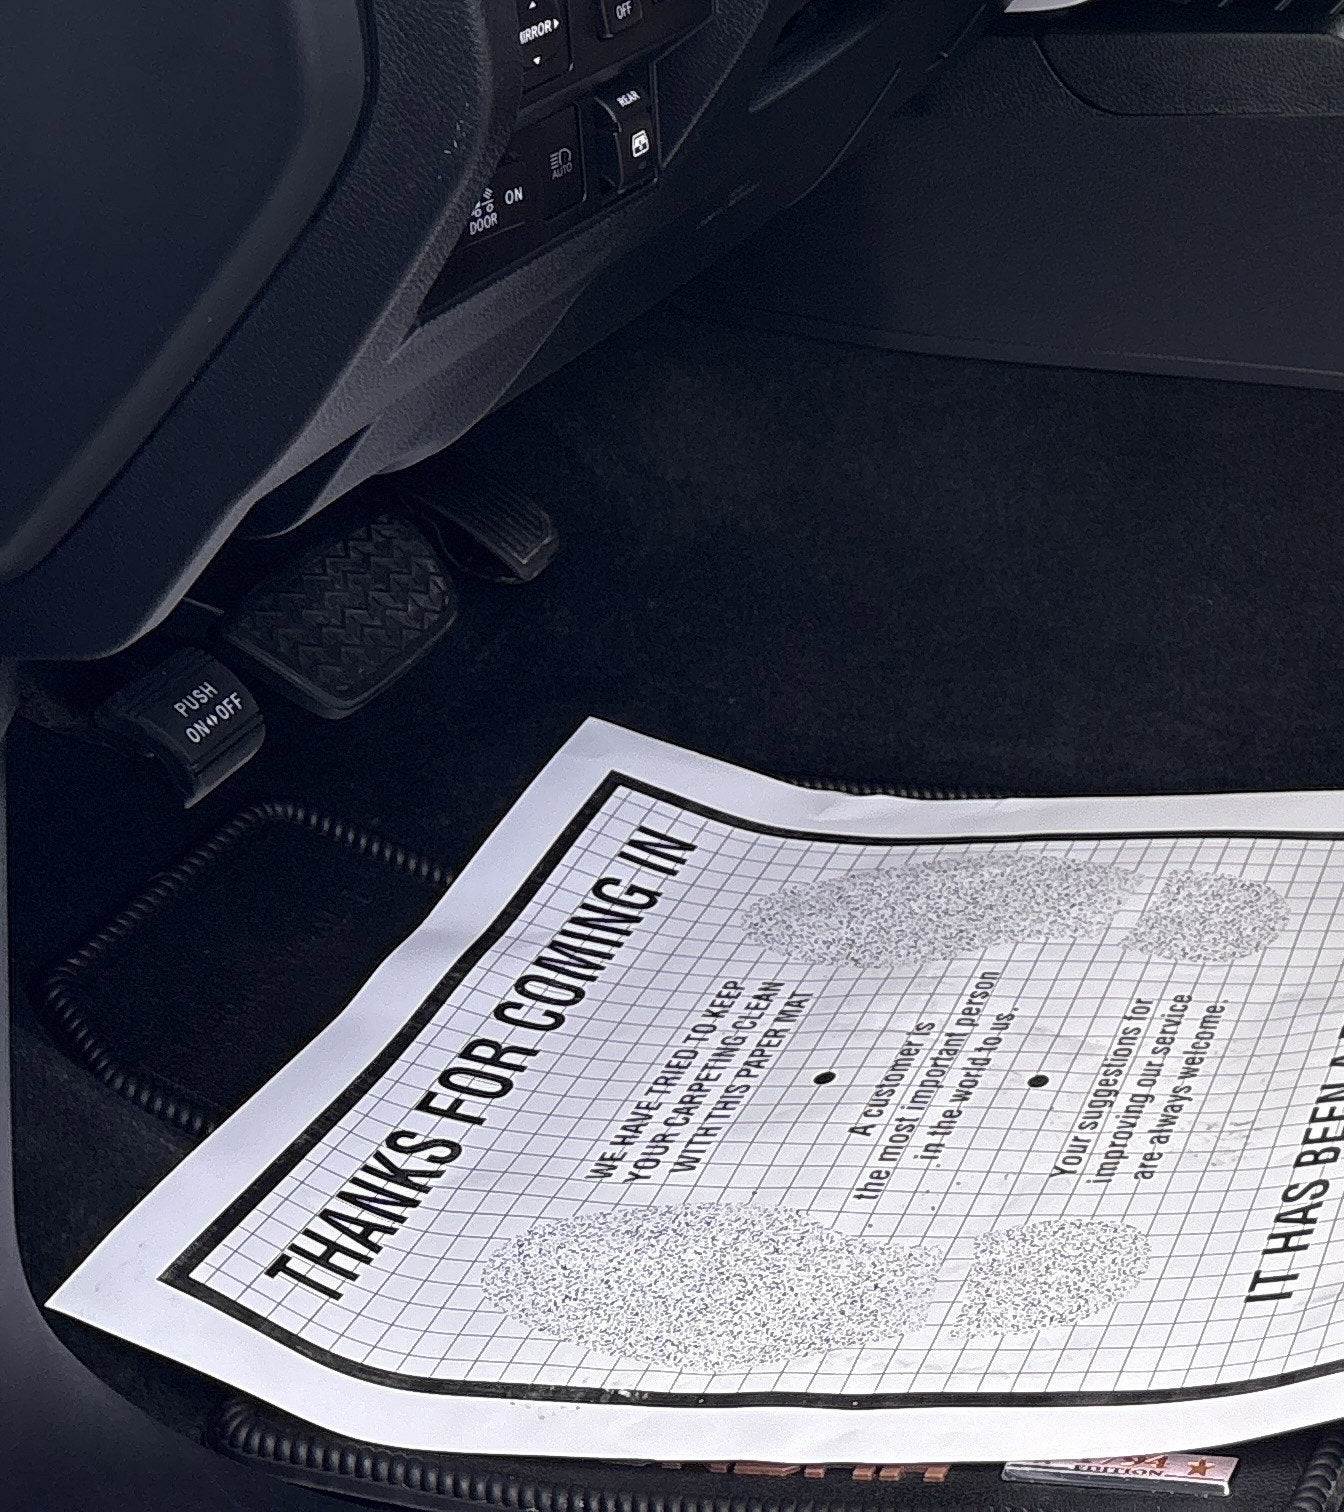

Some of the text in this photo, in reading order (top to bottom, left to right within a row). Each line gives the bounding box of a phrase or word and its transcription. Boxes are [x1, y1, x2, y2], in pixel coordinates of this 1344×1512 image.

[615, 0, 633, 20] OFF
[470, 212, 498, 235] DOOR
[505, 187, 523, 205] ON
[552, 161, 574, 180] AUTO
[173, 681, 218, 717] PUSH
[185, 692, 242, 743] ON OFF
[265, 825, 698, 1301] THANKS FOR COMING IN
[585, 980, 745, 1179] WE HAVE TRIED TO KEEP
[623, 981, 785, 1183] YOUR CARPETING CLEAN
[669, 991, 814, 1172] WITH THIS PAPER MAT
[847, 1021, 936, 1137] A customer is
[853, 971, 1001, 1201] the most important person
[913, 1007, 1020, 1160] in the world to us.
[1050, 998, 1154, 1178] Your suggestions for
[1086, 994, 1193, 1184] improving our service
[1134, 999, 1229, 1180] are always welcome.
[1261, 1178, 1330, 1257] HAS
[1244, 1270, 1299, 1304] IT
[1073, 1464, 1165, 1477] EDITION
